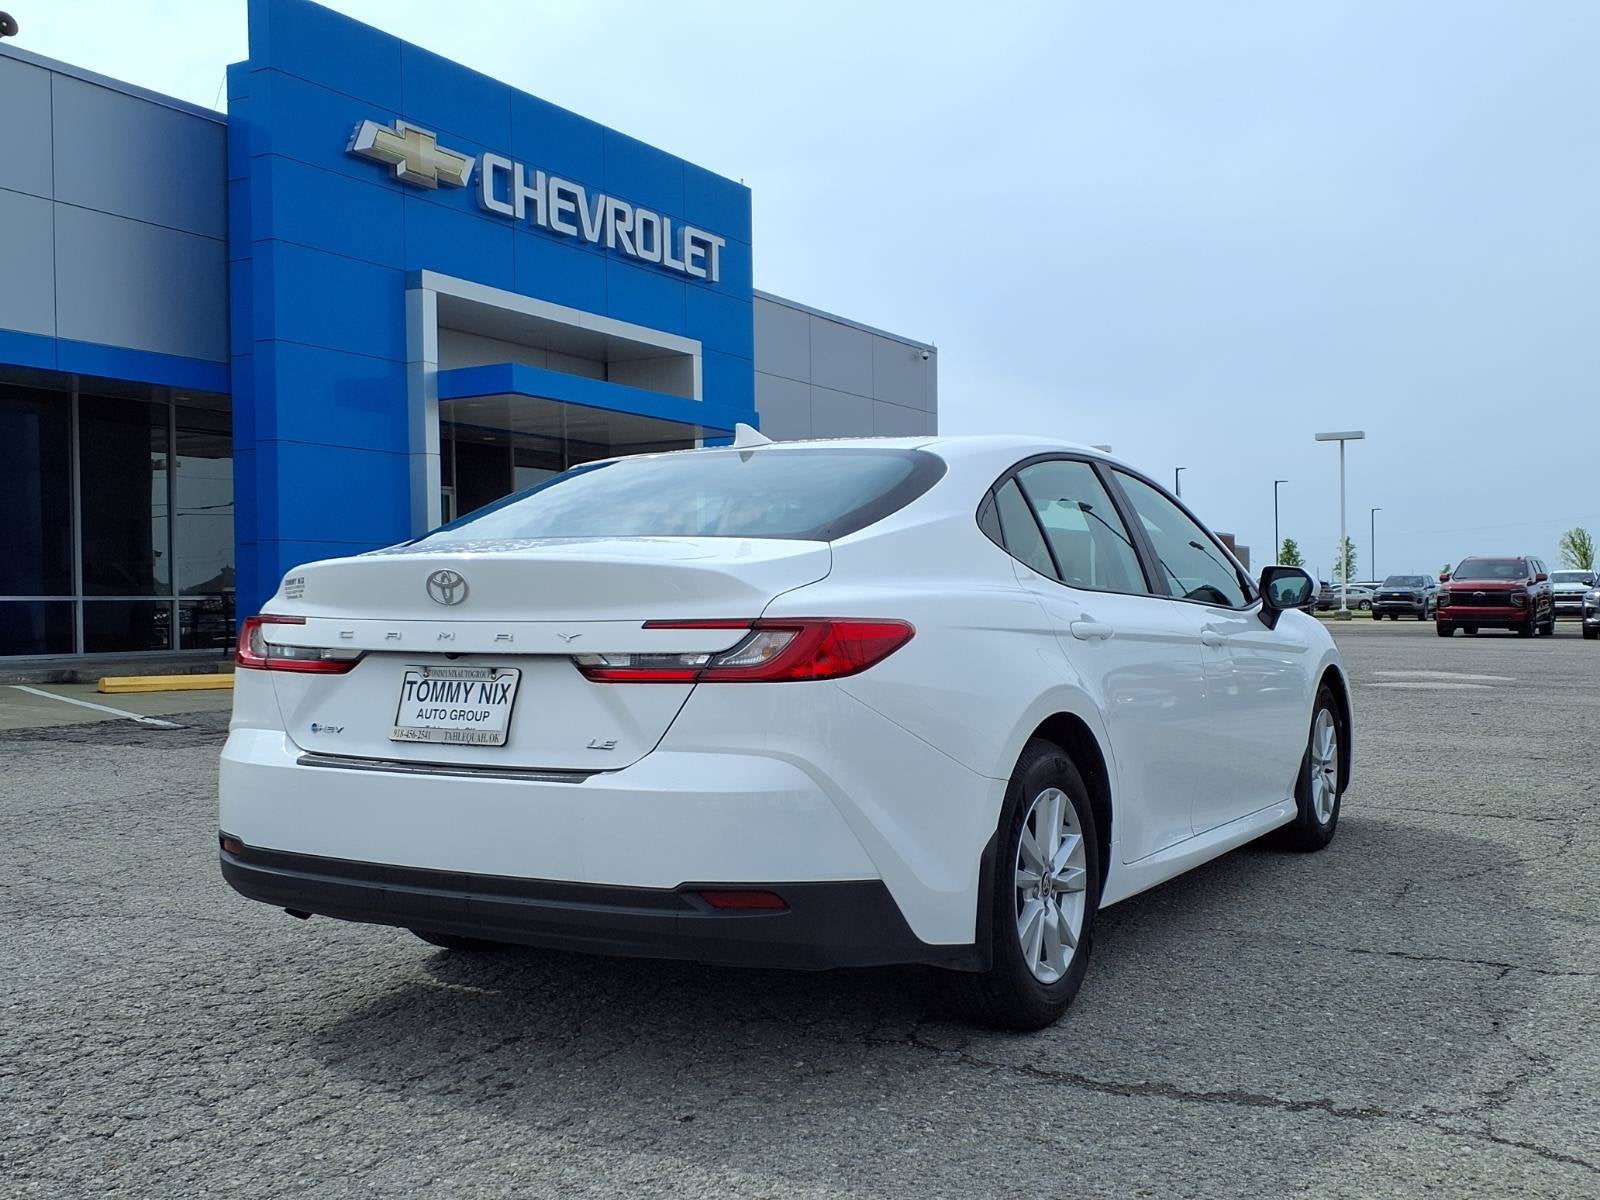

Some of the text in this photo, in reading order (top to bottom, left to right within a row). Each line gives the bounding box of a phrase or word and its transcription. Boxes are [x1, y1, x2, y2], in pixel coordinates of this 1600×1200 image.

[478, 152, 726, 283] CHEVROLET
[339, 630, 583, 643] CAMRY
[406, 680, 512, 705] TOMMY NIX
[416, 708, 490, 722] AUTO GROUP
[586, 739, 618, 751] LE
